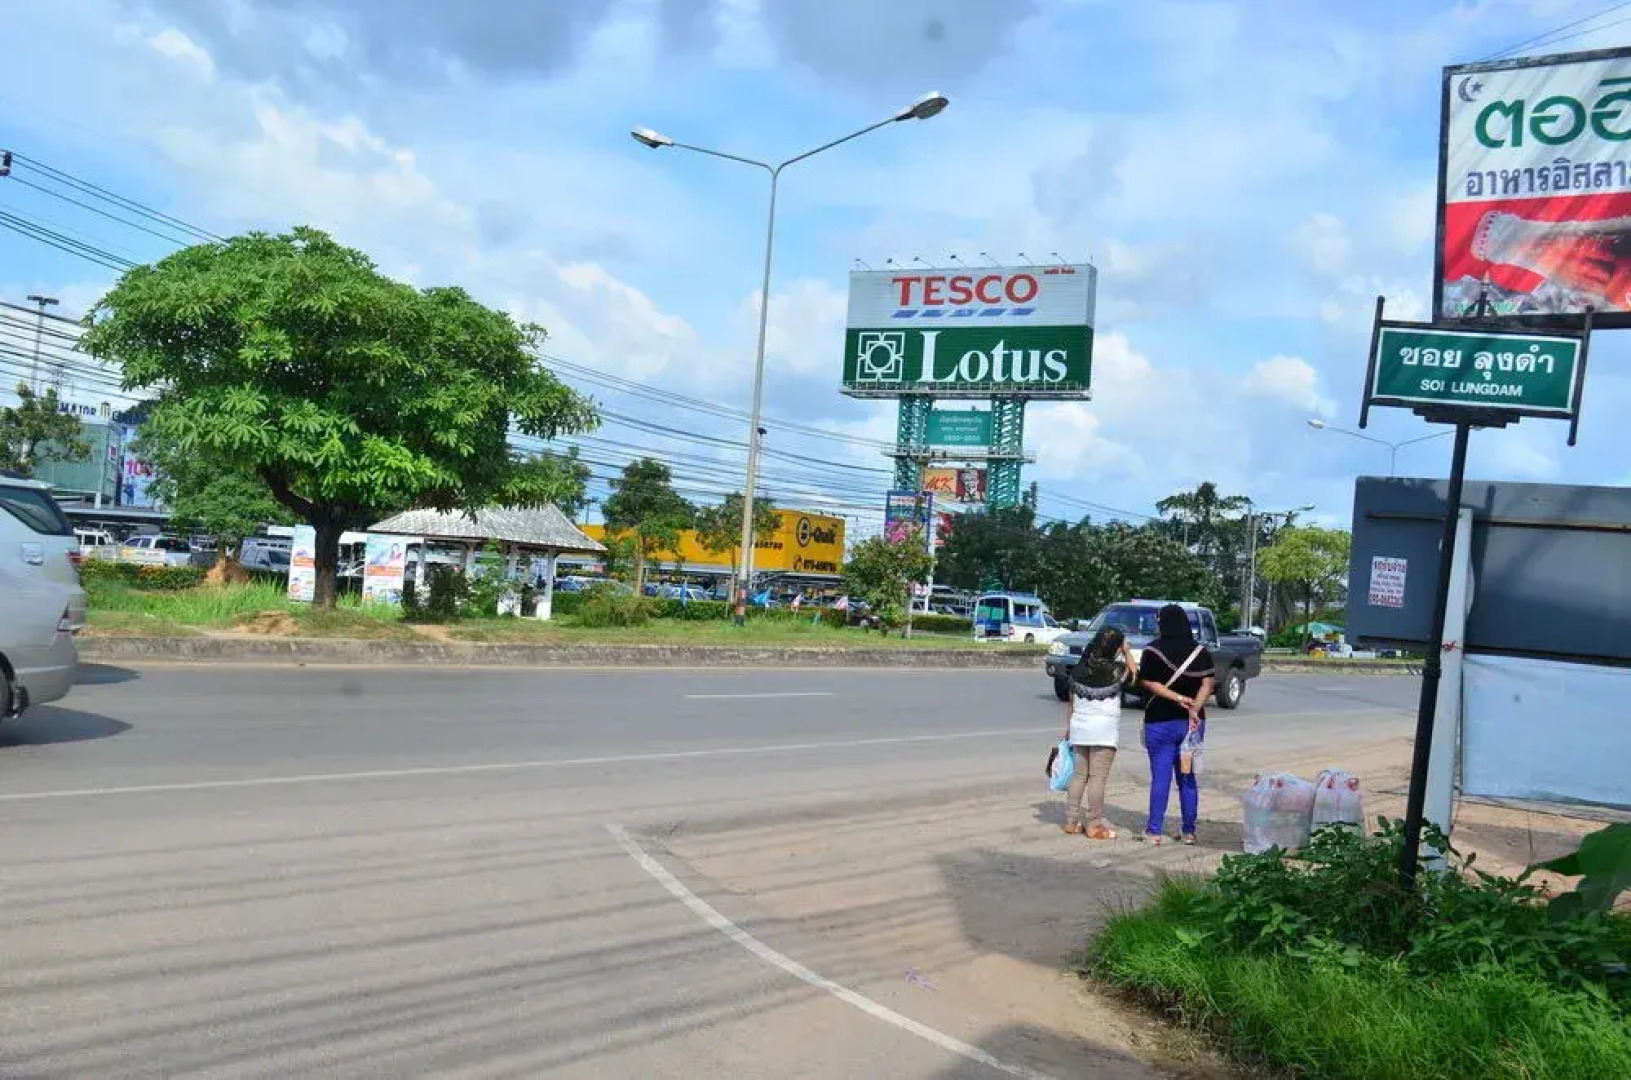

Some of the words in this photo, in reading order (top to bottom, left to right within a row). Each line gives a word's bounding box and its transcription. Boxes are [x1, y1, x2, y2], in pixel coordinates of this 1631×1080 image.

[1475, 77, 1631, 148] ตออ
[1466, 157, 1631, 197] อาหารอิสลา
[892, 273, 1038, 306] TESCO
[917, 330, 1068, 383] Lotus
[1400, 346, 1462, 368] ซอย
[1474, 344, 1555, 381] ลุงดำ
[1420, 379, 1445, 392] SOI
[1451, 381, 1523, 397] LUNGDAM
